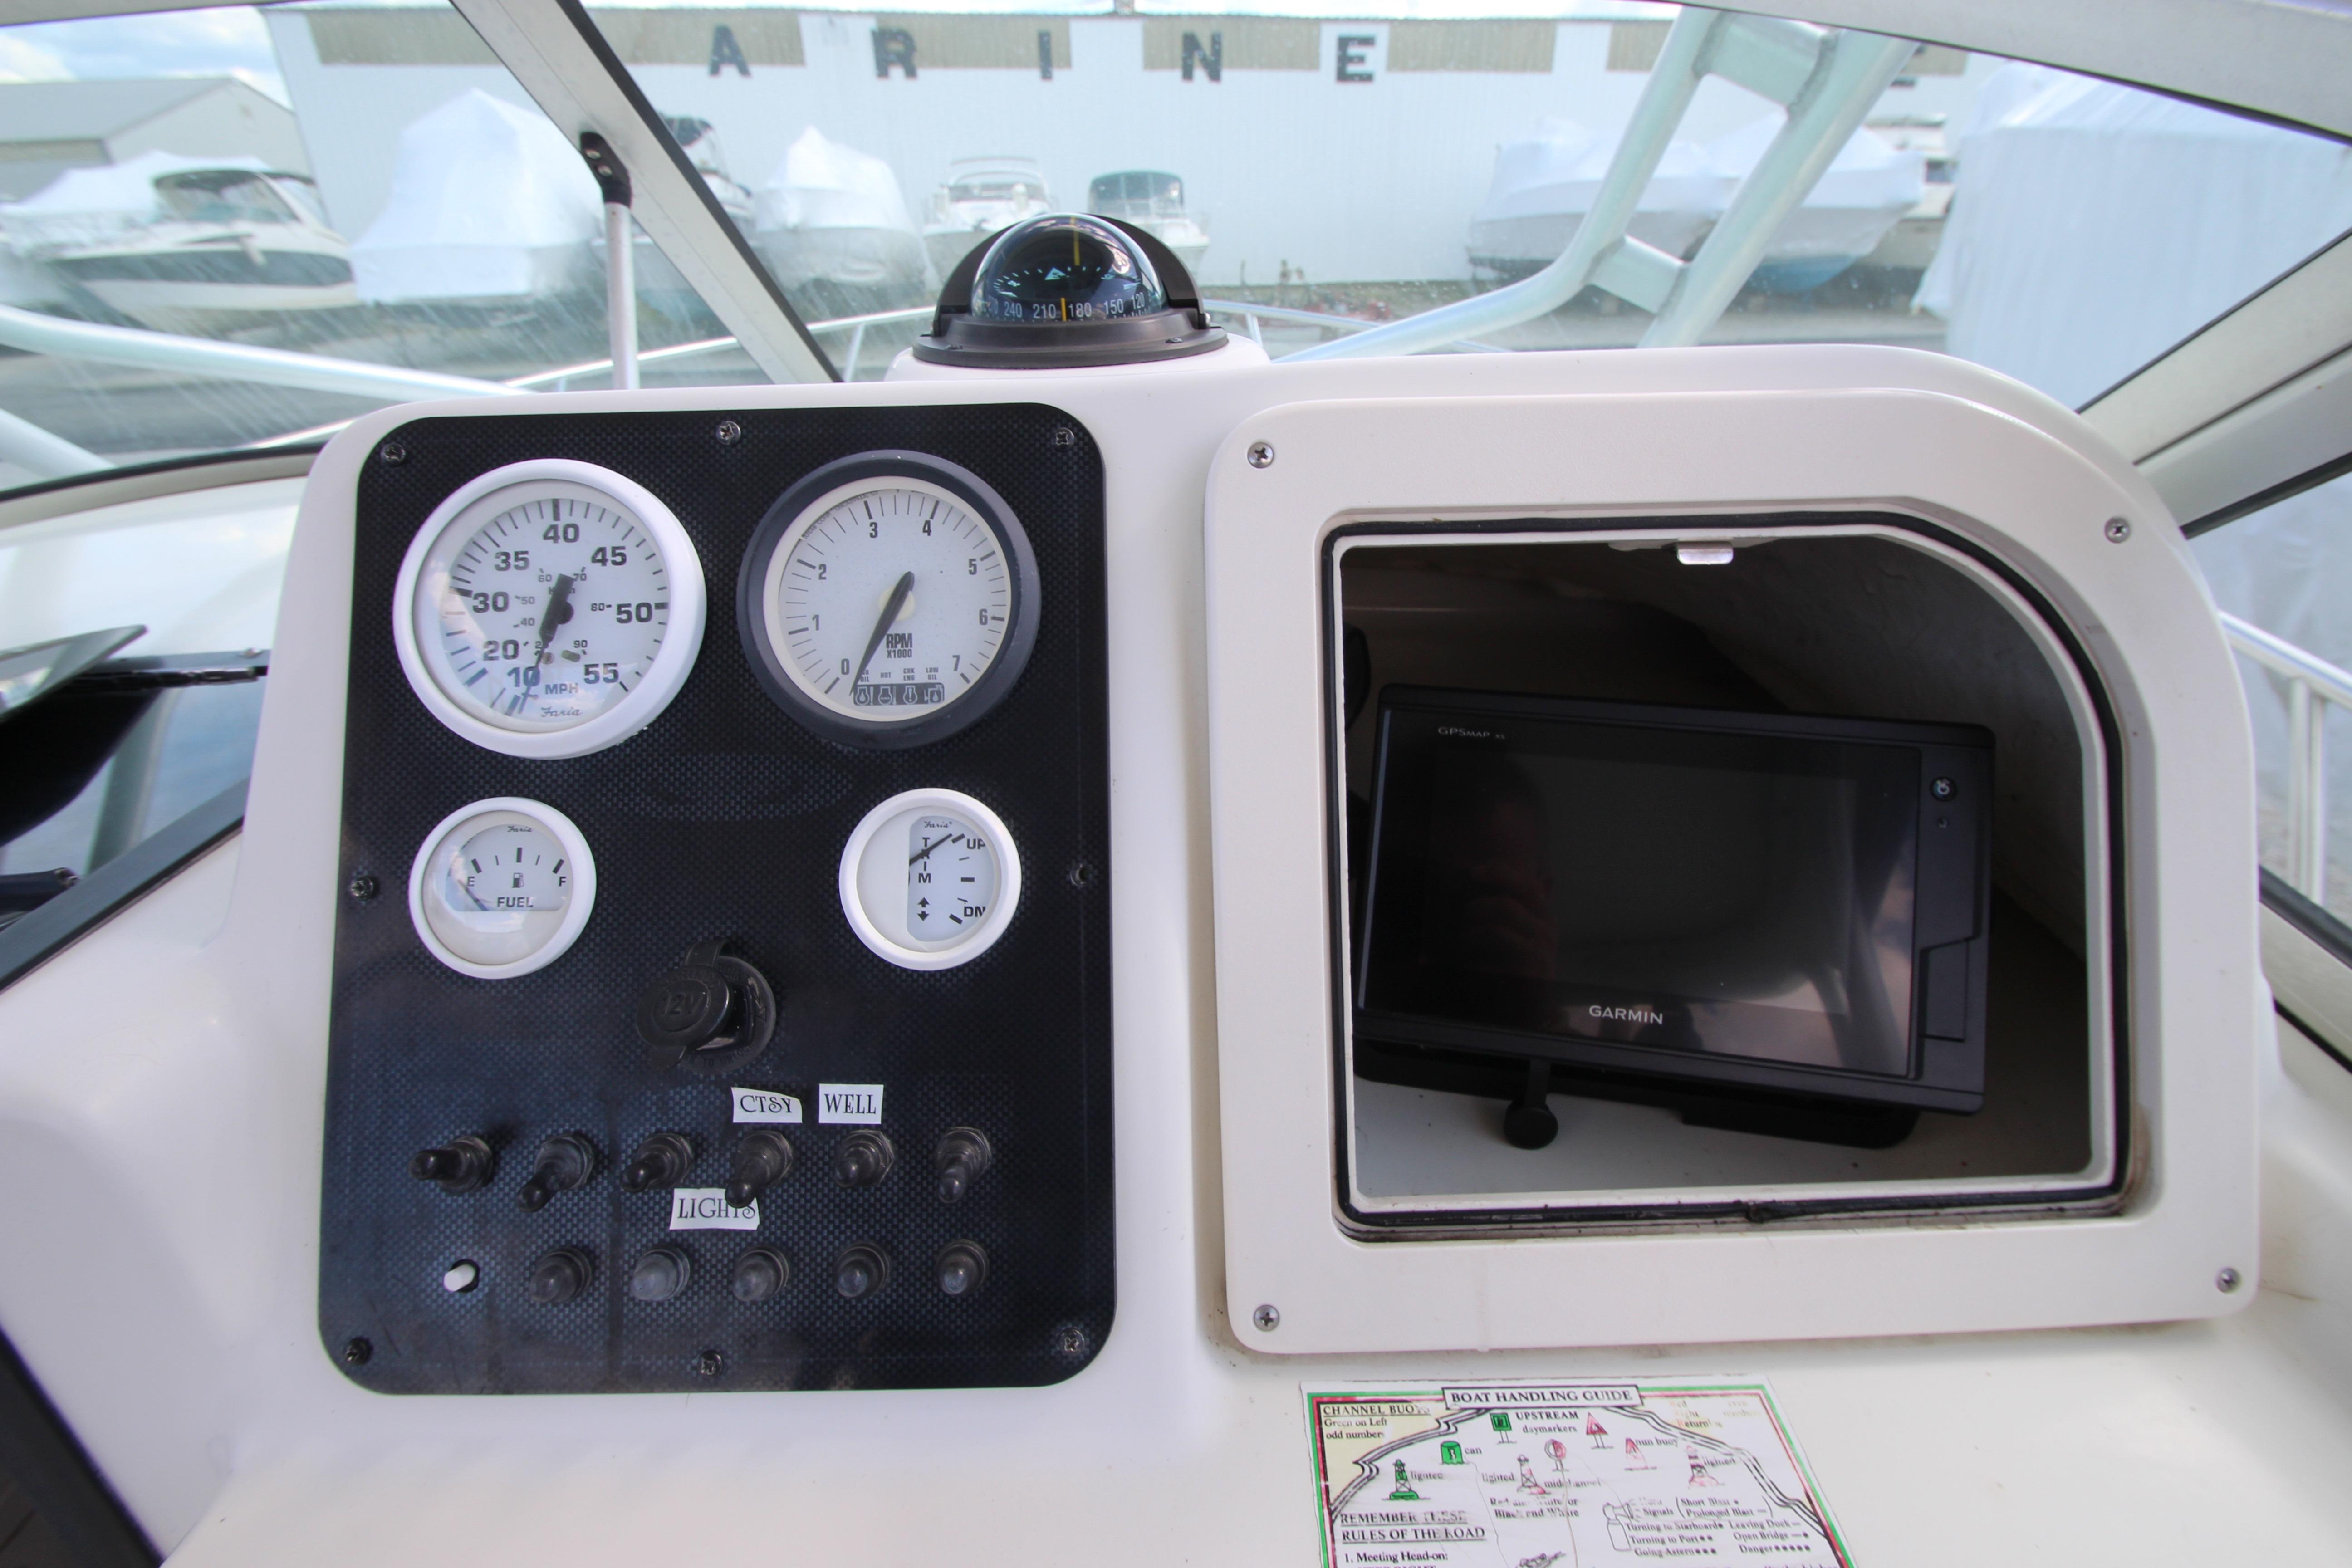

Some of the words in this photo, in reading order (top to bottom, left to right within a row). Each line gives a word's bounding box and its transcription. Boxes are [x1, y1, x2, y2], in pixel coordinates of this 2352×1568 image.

[1104, 299, 1124, 314] 150
[1131, 292, 1145, 309] 120
[1004, 301, 1022, 317] 240
[1033, 304, 1056, 318] 210
[1068, 303, 1092, 317] 180
[543, 523, 580, 544] 40
[869, 522, 878, 539] 3
[922, 520, 931, 536] 4
[495, 551, 529, 571] 35
[591, 546, 627, 567] 45
[818, 564, 828, 580] 2
[969, 559, 978, 575] 5
[538, 573, 552, 583] 60
[573, 573, 587, 582] 70
[472, 591, 510, 613] 30
[520, 596, 534, 605] 50
[616, 602, 653, 624] 50
[979, 609, 988, 626] 6
[520, 617, 534, 627] 40
[812, 615, 820, 631] 1
[573, 640, 588, 648] 90
[886, 633, 913, 649] RPM
[483, 640, 519, 661] 20
[887, 649, 912, 659] X1000
[841, 658, 850, 675] 0
[952, 655, 960, 671] 7
[507, 666, 541, 687] 10
[583, 663, 619, 684] 55
[545, 683, 578, 695] MPH
[541, 706, 582, 718] Faria
[967, 838, 986, 849] UP
[467, 877, 475, 887] E
[559, 876, 567, 887] F
[497, 897, 534, 907] FUEL
[1589, 1005, 1663, 1025] GARMIN
[740, 1095, 792, 1113] CTSY
[824, 1094, 877, 1114] WELL
[1452, 1392, 1490, 1403] BOAT
[1497, 1391, 1578, 1402] HANDLING
[1583, 1390, 1632, 1401] GUIDE
[1323, 1405, 1385, 1415] CHANNEL
[1515, 1411, 1579, 1421] UPSTREAM
[1369, 1418, 1387, 1426] Left
[1326, 1430, 1343, 1439] odd
[1522, 1424, 1578, 1435] daymarkers
[1681, 1498, 1705, 1507] Short
[1341, 1512, 1416, 1524] REMEMBER
[1643, 1508, 1674, 1518] Signals
[1686, 1509, 1731, 1520] Prolonged
[1732, 1508, 1754, 1516] Blast
[1624, 1522, 1661, 1532] Turning
[1663, 1522, 1673, 1530] to
[1676, 1521, 1718, 1531] Starboard
[1728, 1519, 1764, 1530] Leaving
[1765, 1519, 1791, 1528] Dock
[1343, 1529, 1386, 1541] RULES
[1389, 1529, 1407, 1539] OF
[1411, 1528, 1441, 1539] THE
[1629, 1534, 1666, 1544] Turning
[1732, 1532, 1757, 1541] Open
[1758, 1531, 1789, 1541] Bridge
[1634, 1547, 1663, 1558] Going
[1665, 1547, 1695, 1556] Astern
[1739, 1545, 1774, 1555] Danger
[1345, 1553, 1353, 1563] 1.
[1356, 1551, 1399, 1563] Meeting
[1400, 1551, 1448, 1561] Head-on:
